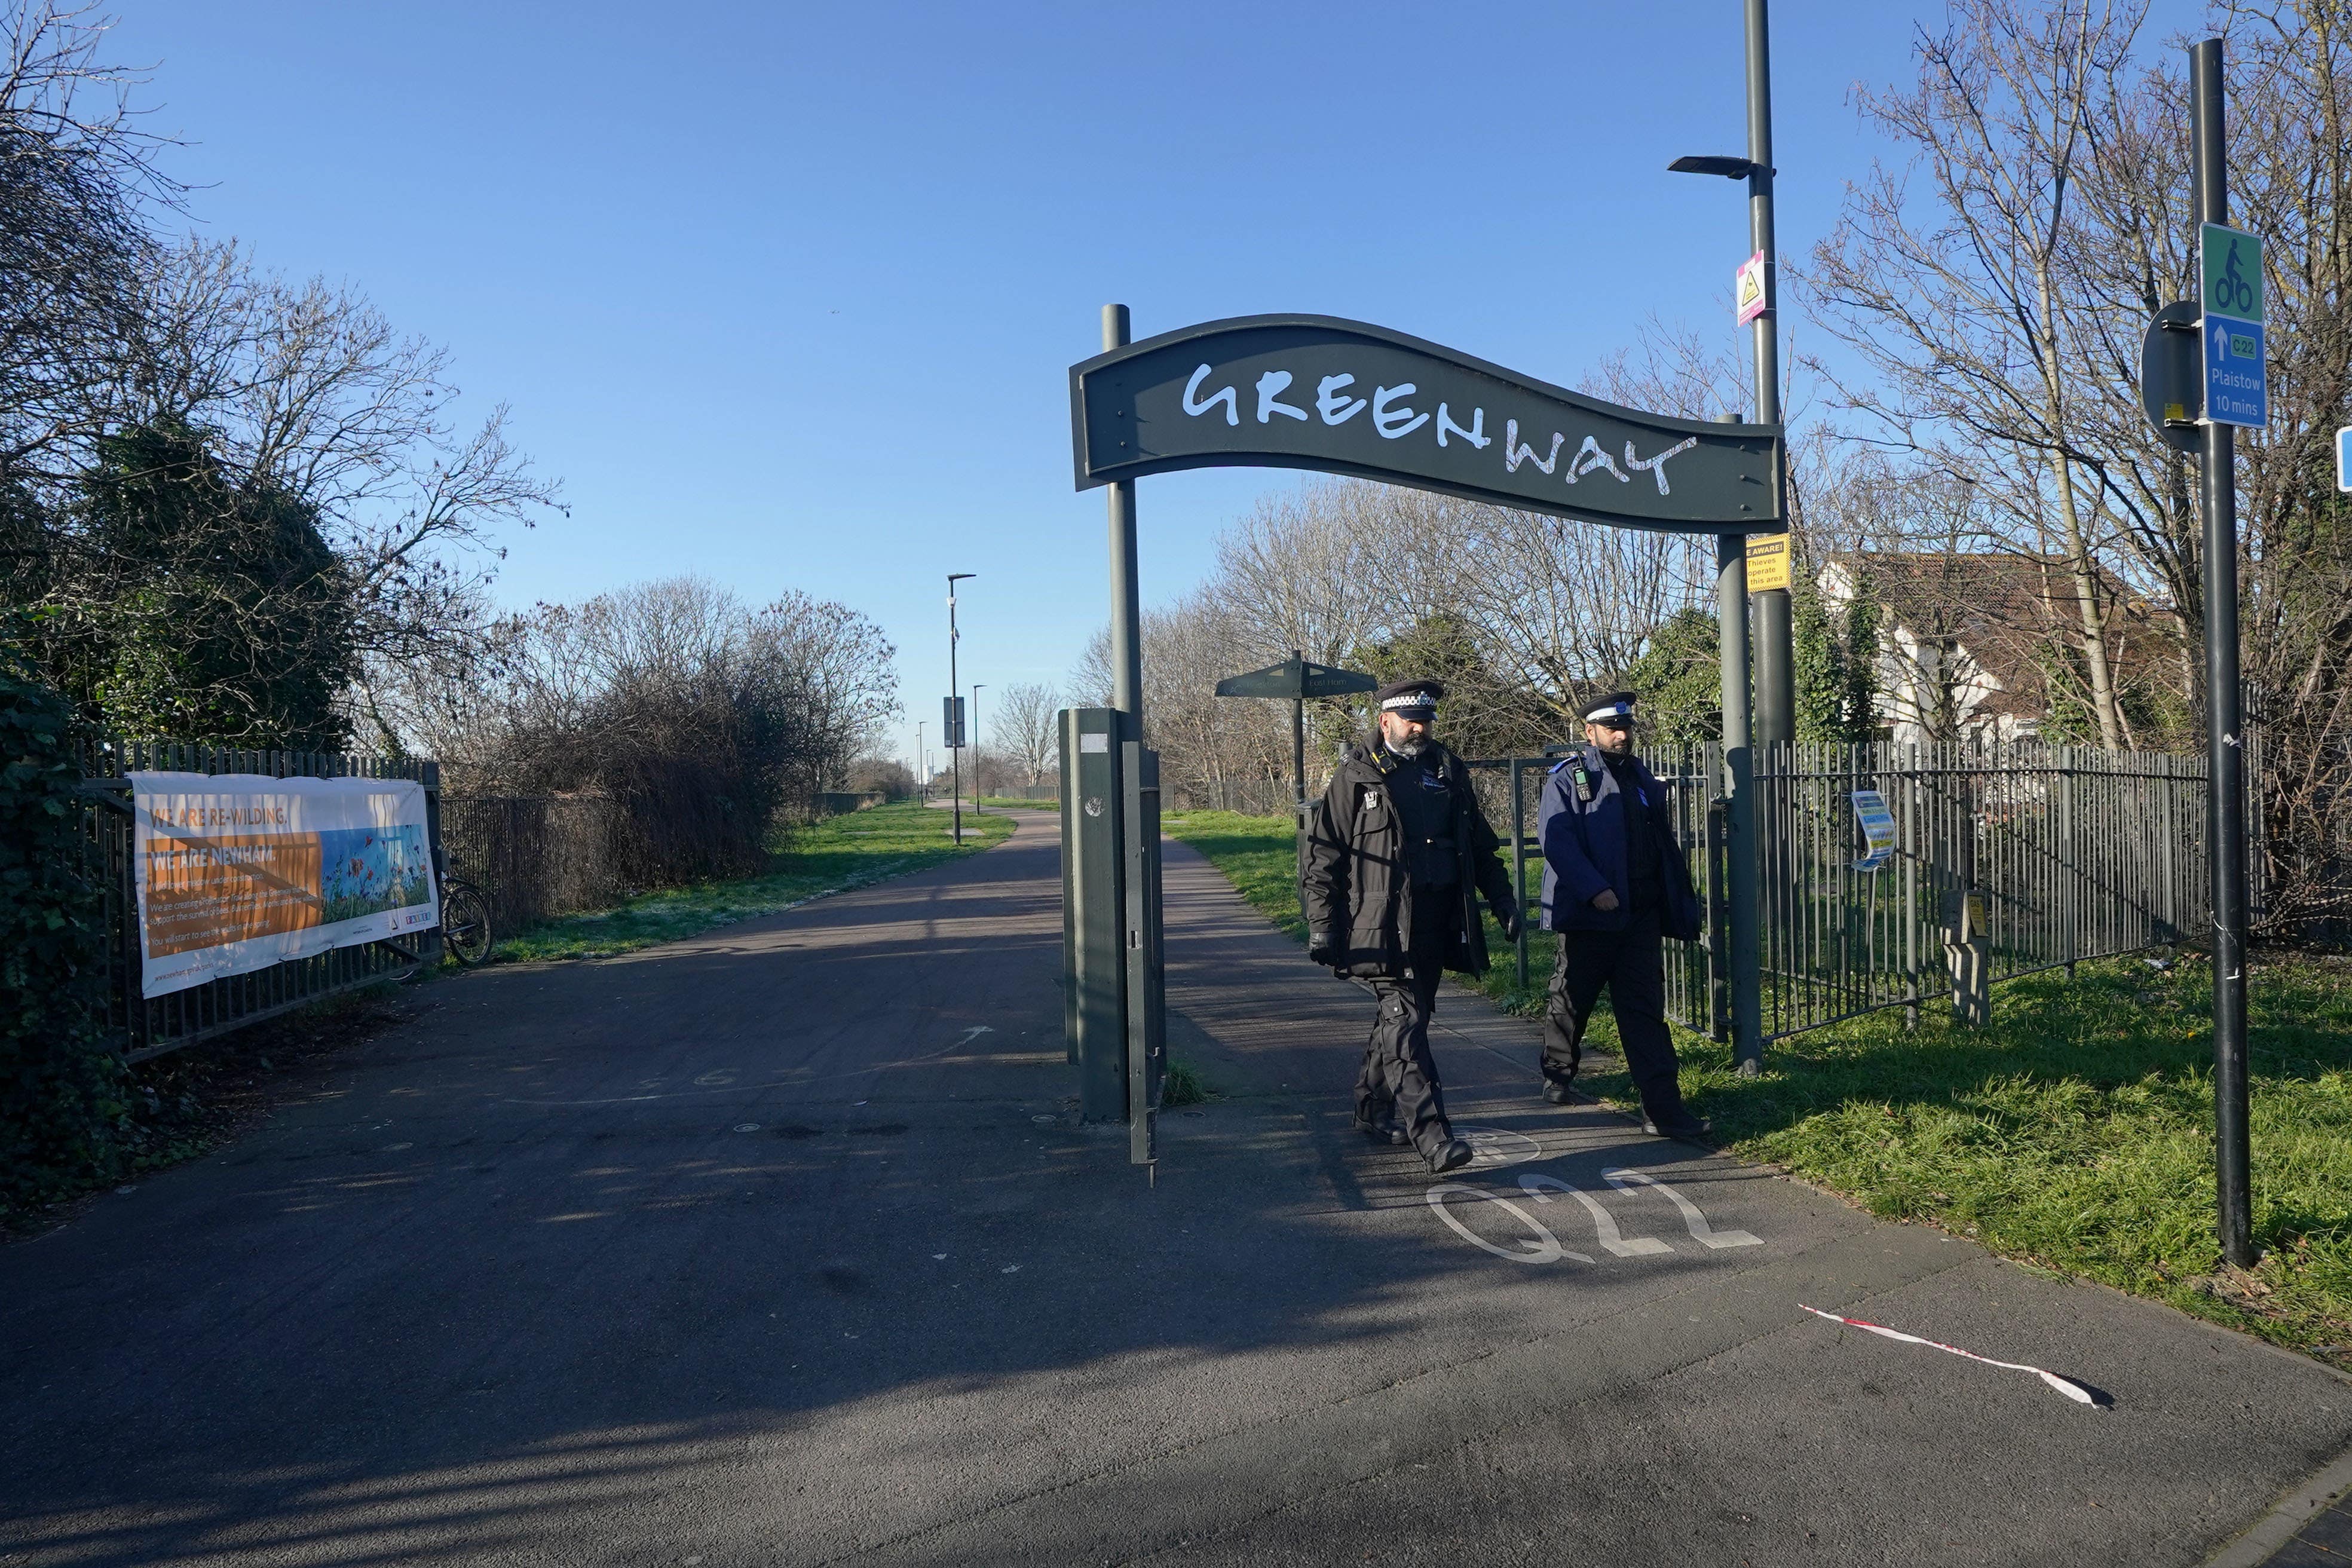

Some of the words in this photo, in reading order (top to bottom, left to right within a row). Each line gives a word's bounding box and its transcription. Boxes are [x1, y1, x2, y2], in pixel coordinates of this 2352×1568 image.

[2232, 339, 2254, 354] C22
[2212, 368, 2261, 391] Plaistow
[2216, 394, 2229, 412] 10
[2232, 399, 2258, 416] mins
[1183, 364, 1697, 495] GREENWAY
[1753, 544, 1783, 555] AWARE!
[1748, 558, 1776, 567] Thieves
[1748, 567, 1775, 577] operate
[149, 808, 174, 828] WE
[179, 808, 206, 826] ARE
[210, 807, 287, 826] RE-WILDING.
[151, 850, 175, 870] WE
[180, 848, 207, 869] ARE
[211, 844, 276, 866] NEWHAM.
[211, 875, 229, 884] under
[149, 904, 164, 912] We
[174, 900, 198, 909] creating
[149, 915, 175, 926] support
[176, 912, 188, 921] the
[151, 938, 163, 947] You
[174, 932, 190, 942] start
[191, 931, 198, 939] to
[1426, 1167, 1765, 1264] Q22
